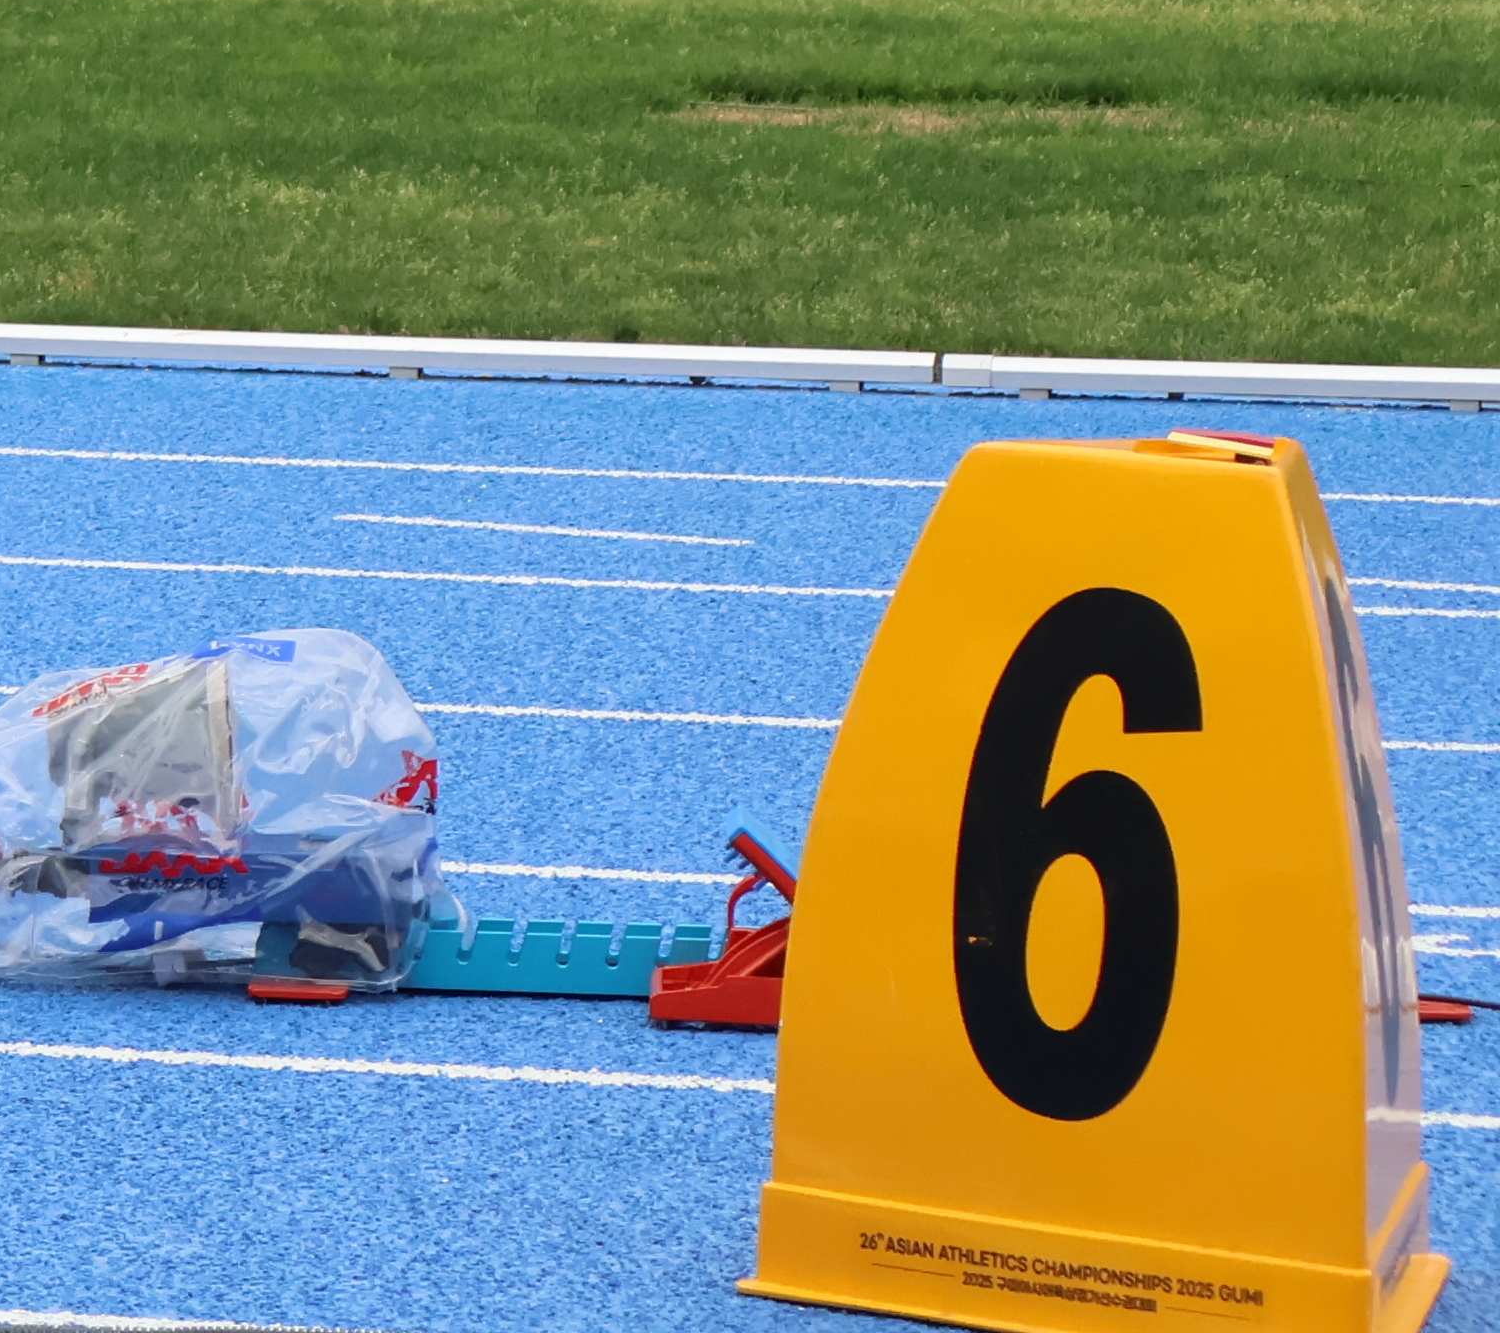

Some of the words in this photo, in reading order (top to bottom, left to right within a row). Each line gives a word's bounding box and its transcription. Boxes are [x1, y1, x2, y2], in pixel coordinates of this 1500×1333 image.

[953, 586, 1204, 1122] 6
[885, 1237, 934, 1259] ASIAN
[938, 1245, 1029, 1272] ATHLETICS
[1032, 1258, 1173, 1294] CHAMPIONSHIPS
[1177, 1278, 1214, 1300] 2025
[1218, 1284, 1264, 1307] GUMI
